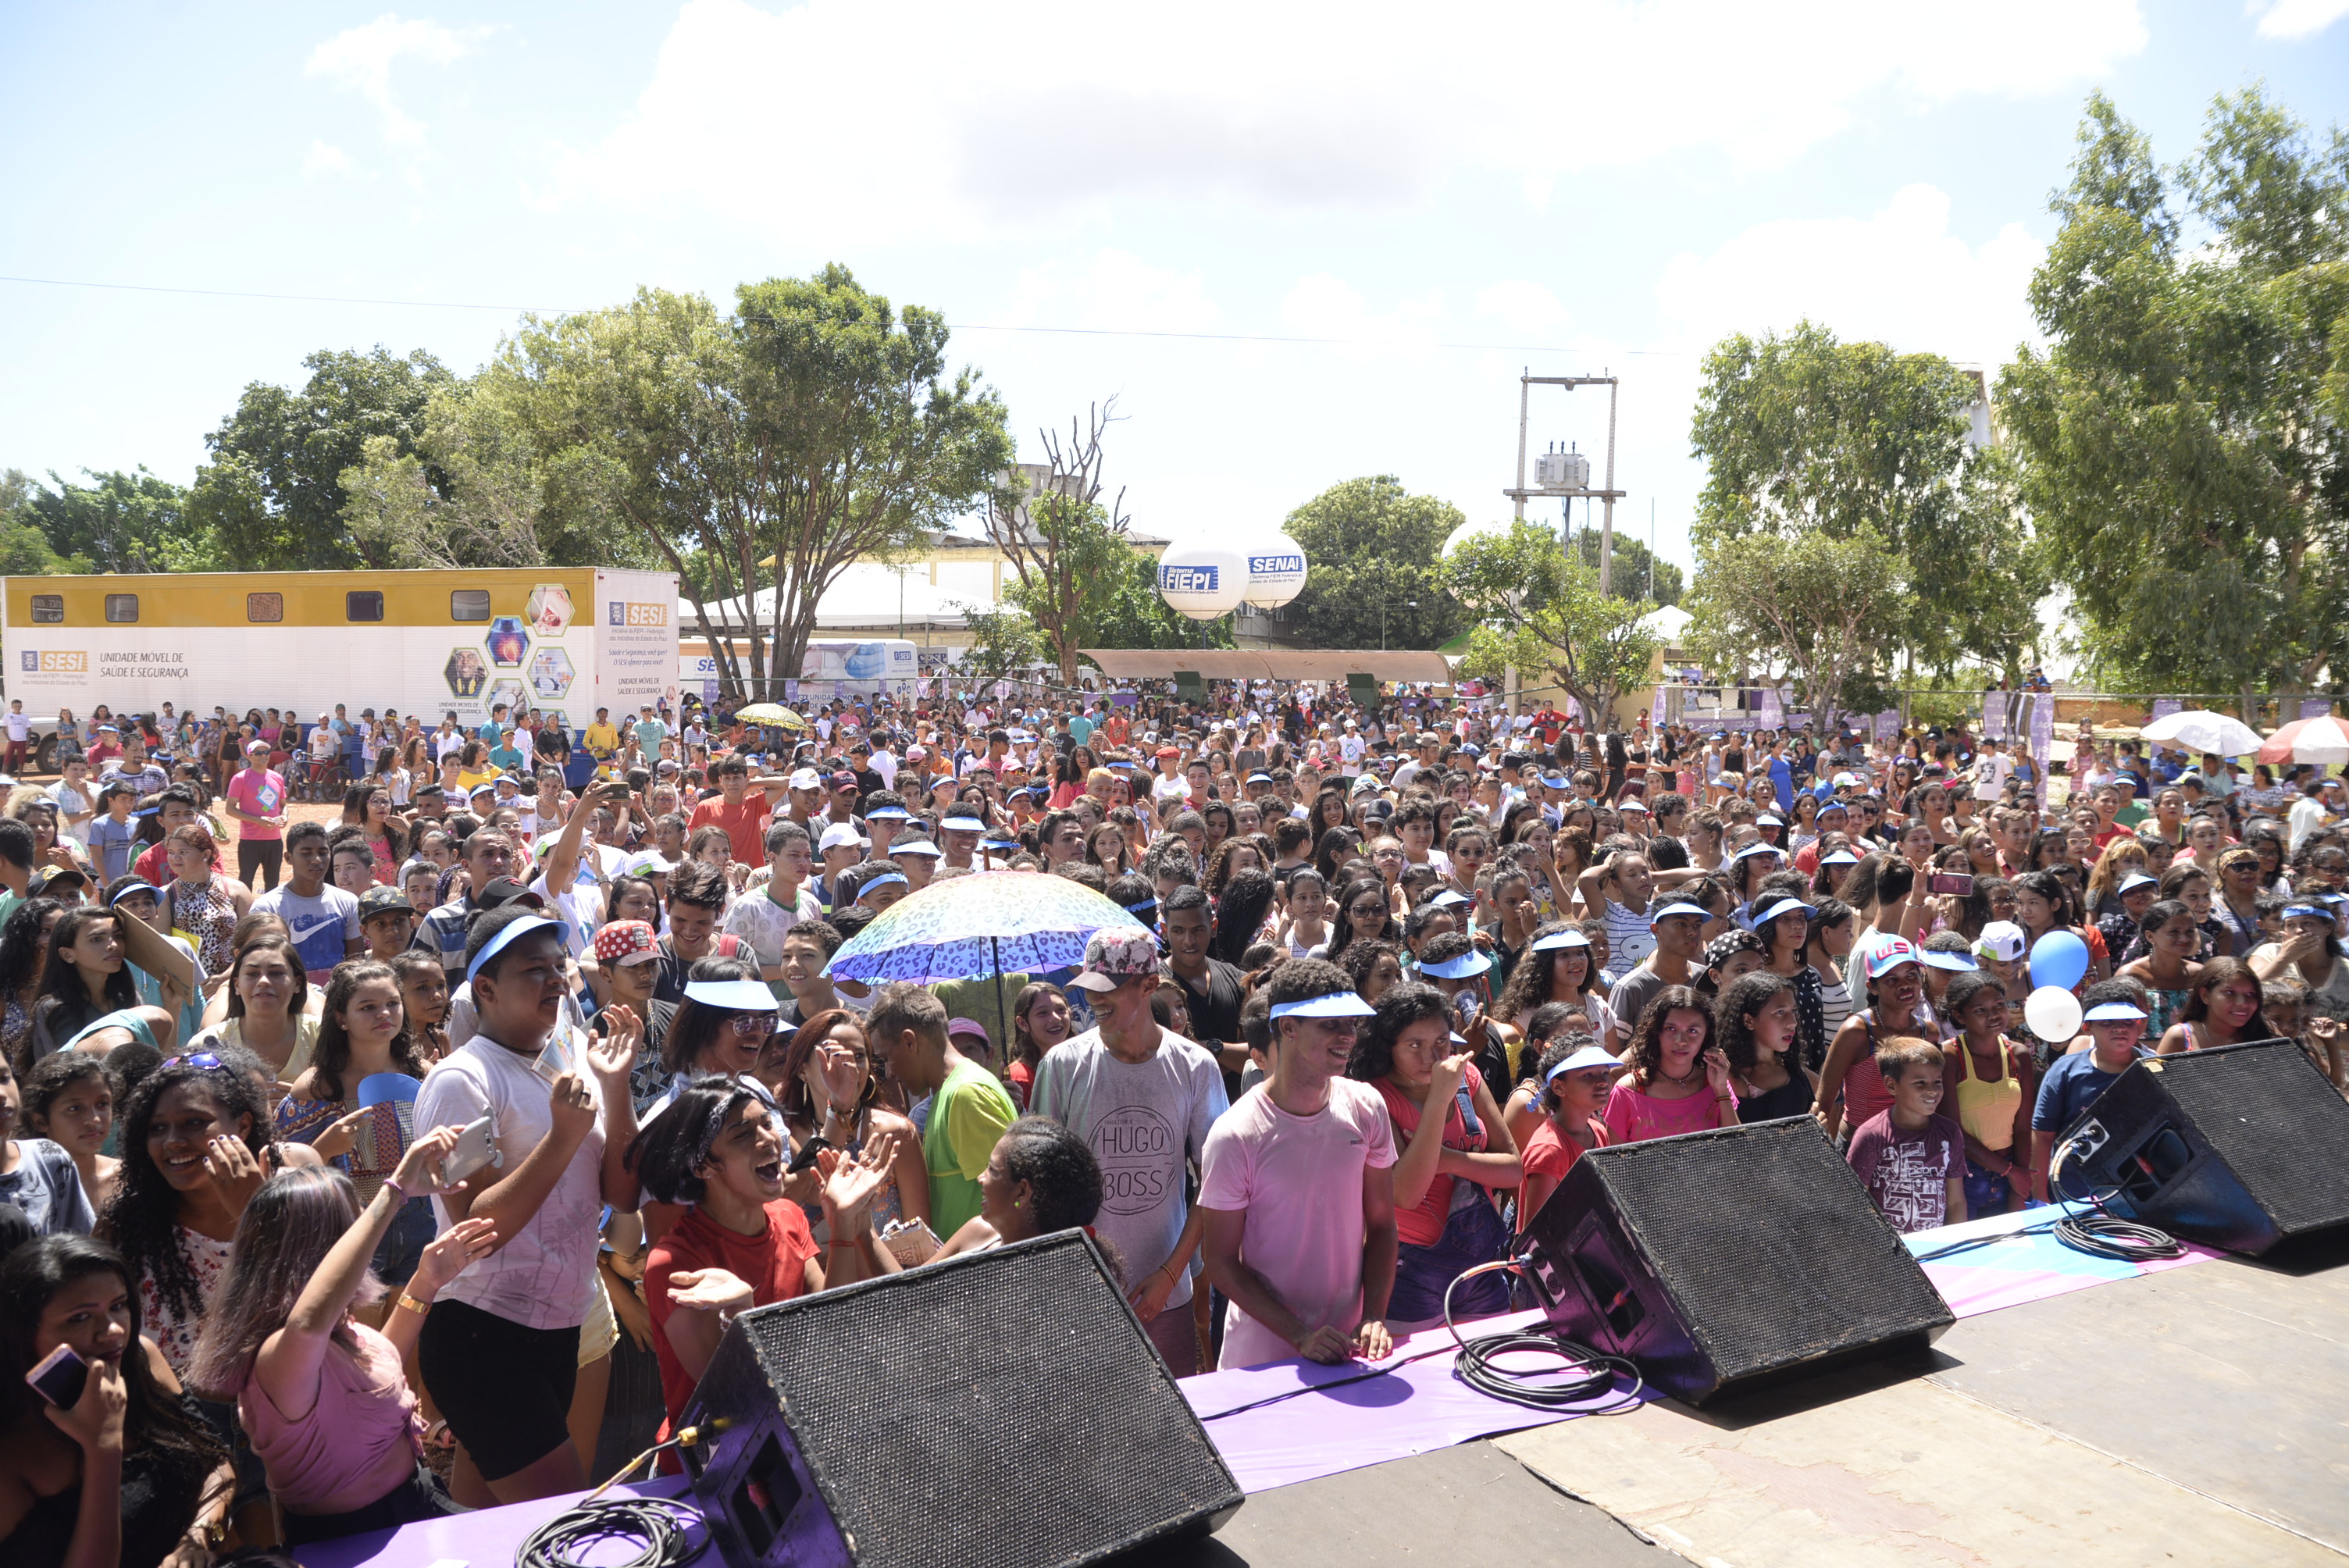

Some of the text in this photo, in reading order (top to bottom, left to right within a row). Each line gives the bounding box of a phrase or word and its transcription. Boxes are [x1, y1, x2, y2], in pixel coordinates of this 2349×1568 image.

[1253, 557, 1299, 572] SENAI
[1166, 573, 1211, 590] FIEPI
[629, 605, 664, 625] SESI
[44, 653, 84, 670] SESI
[100, 650, 184, 663] UNIDADE MÓVEL DE
[900, 651, 911, 661] SESI
[100, 665, 189, 680] SAÚDE E SEGURANÇA
[640, 676, 654, 685] MÓVEL
[617, 686, 632, 695] SAÚDE
[636, 687, 661, 696] SEGURANÇA
[1103, 1126, 1164, 1154] HUGO
[1104, 1170, 1163, 1201] BOSS
